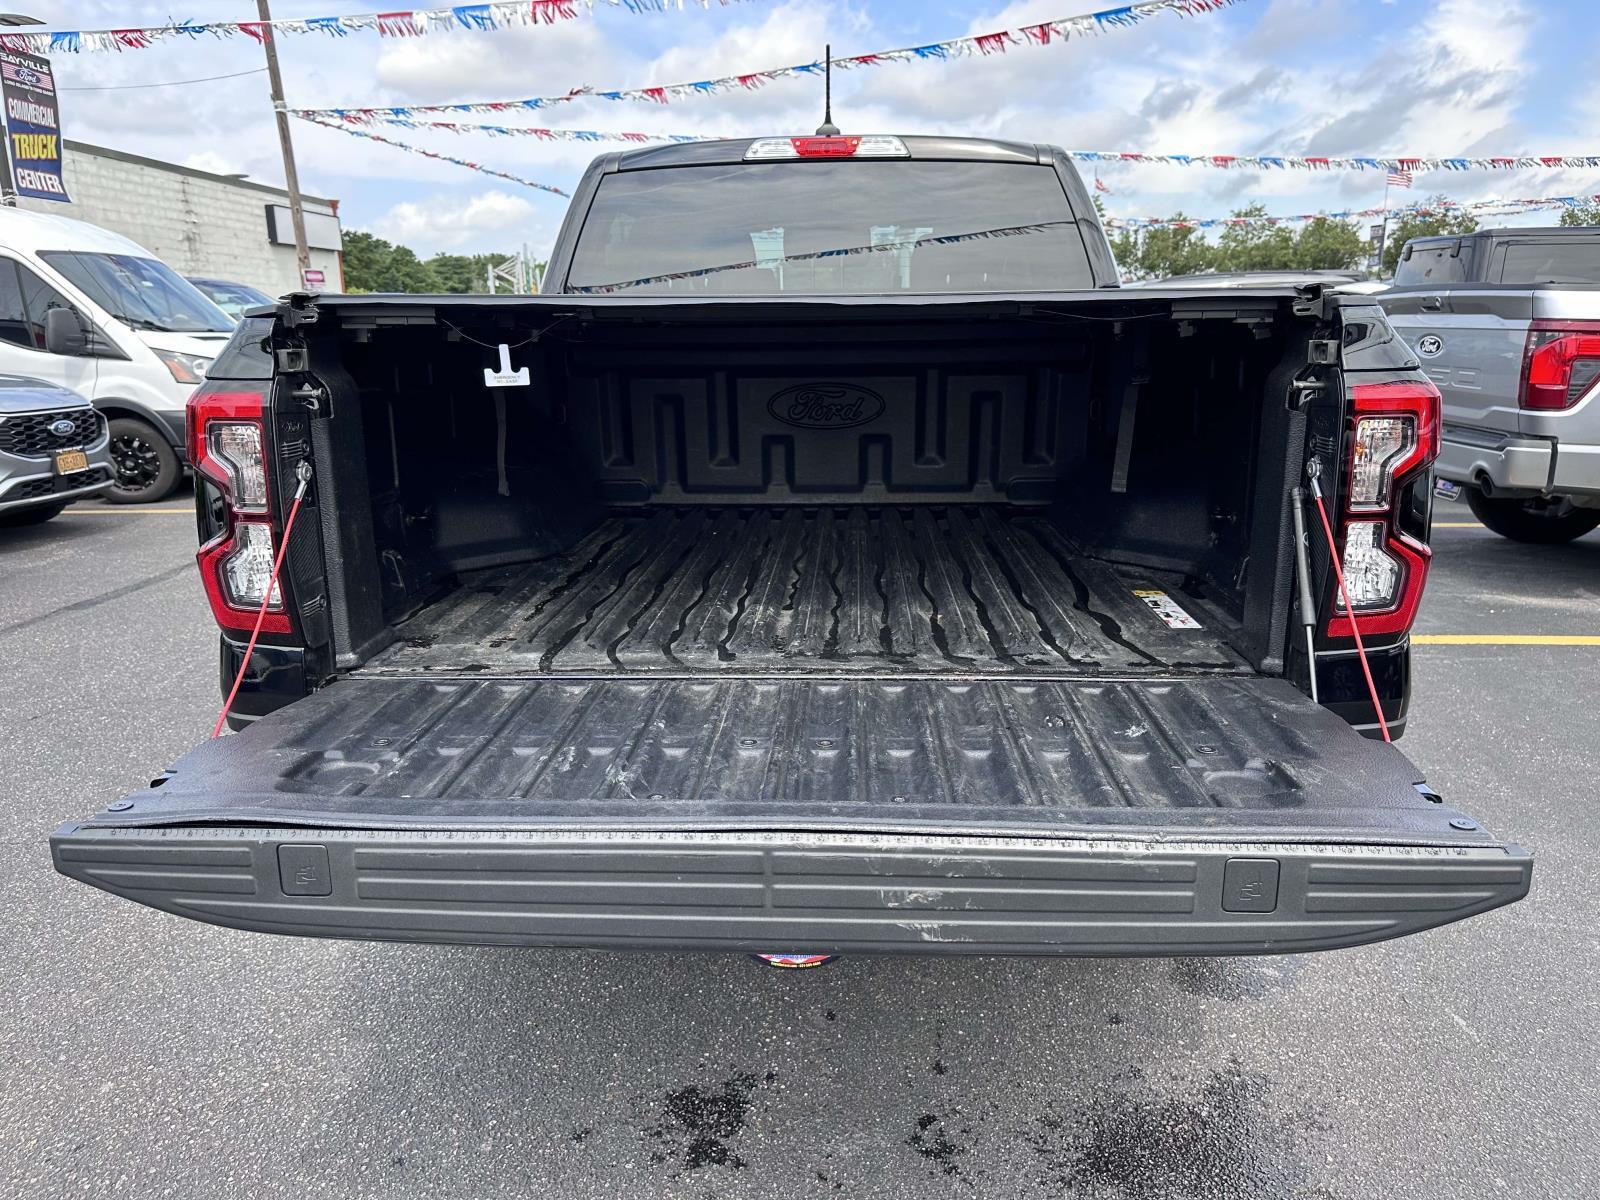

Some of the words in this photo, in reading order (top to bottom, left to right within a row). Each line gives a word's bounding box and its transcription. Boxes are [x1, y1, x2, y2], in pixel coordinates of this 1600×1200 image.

[9, 98, 56, 128] COMMERCIAL
[12, 134, 57, 159] TRUCK
[17, 168, 63, 193] CENTER
[788, 389, 864, 421] Ford
